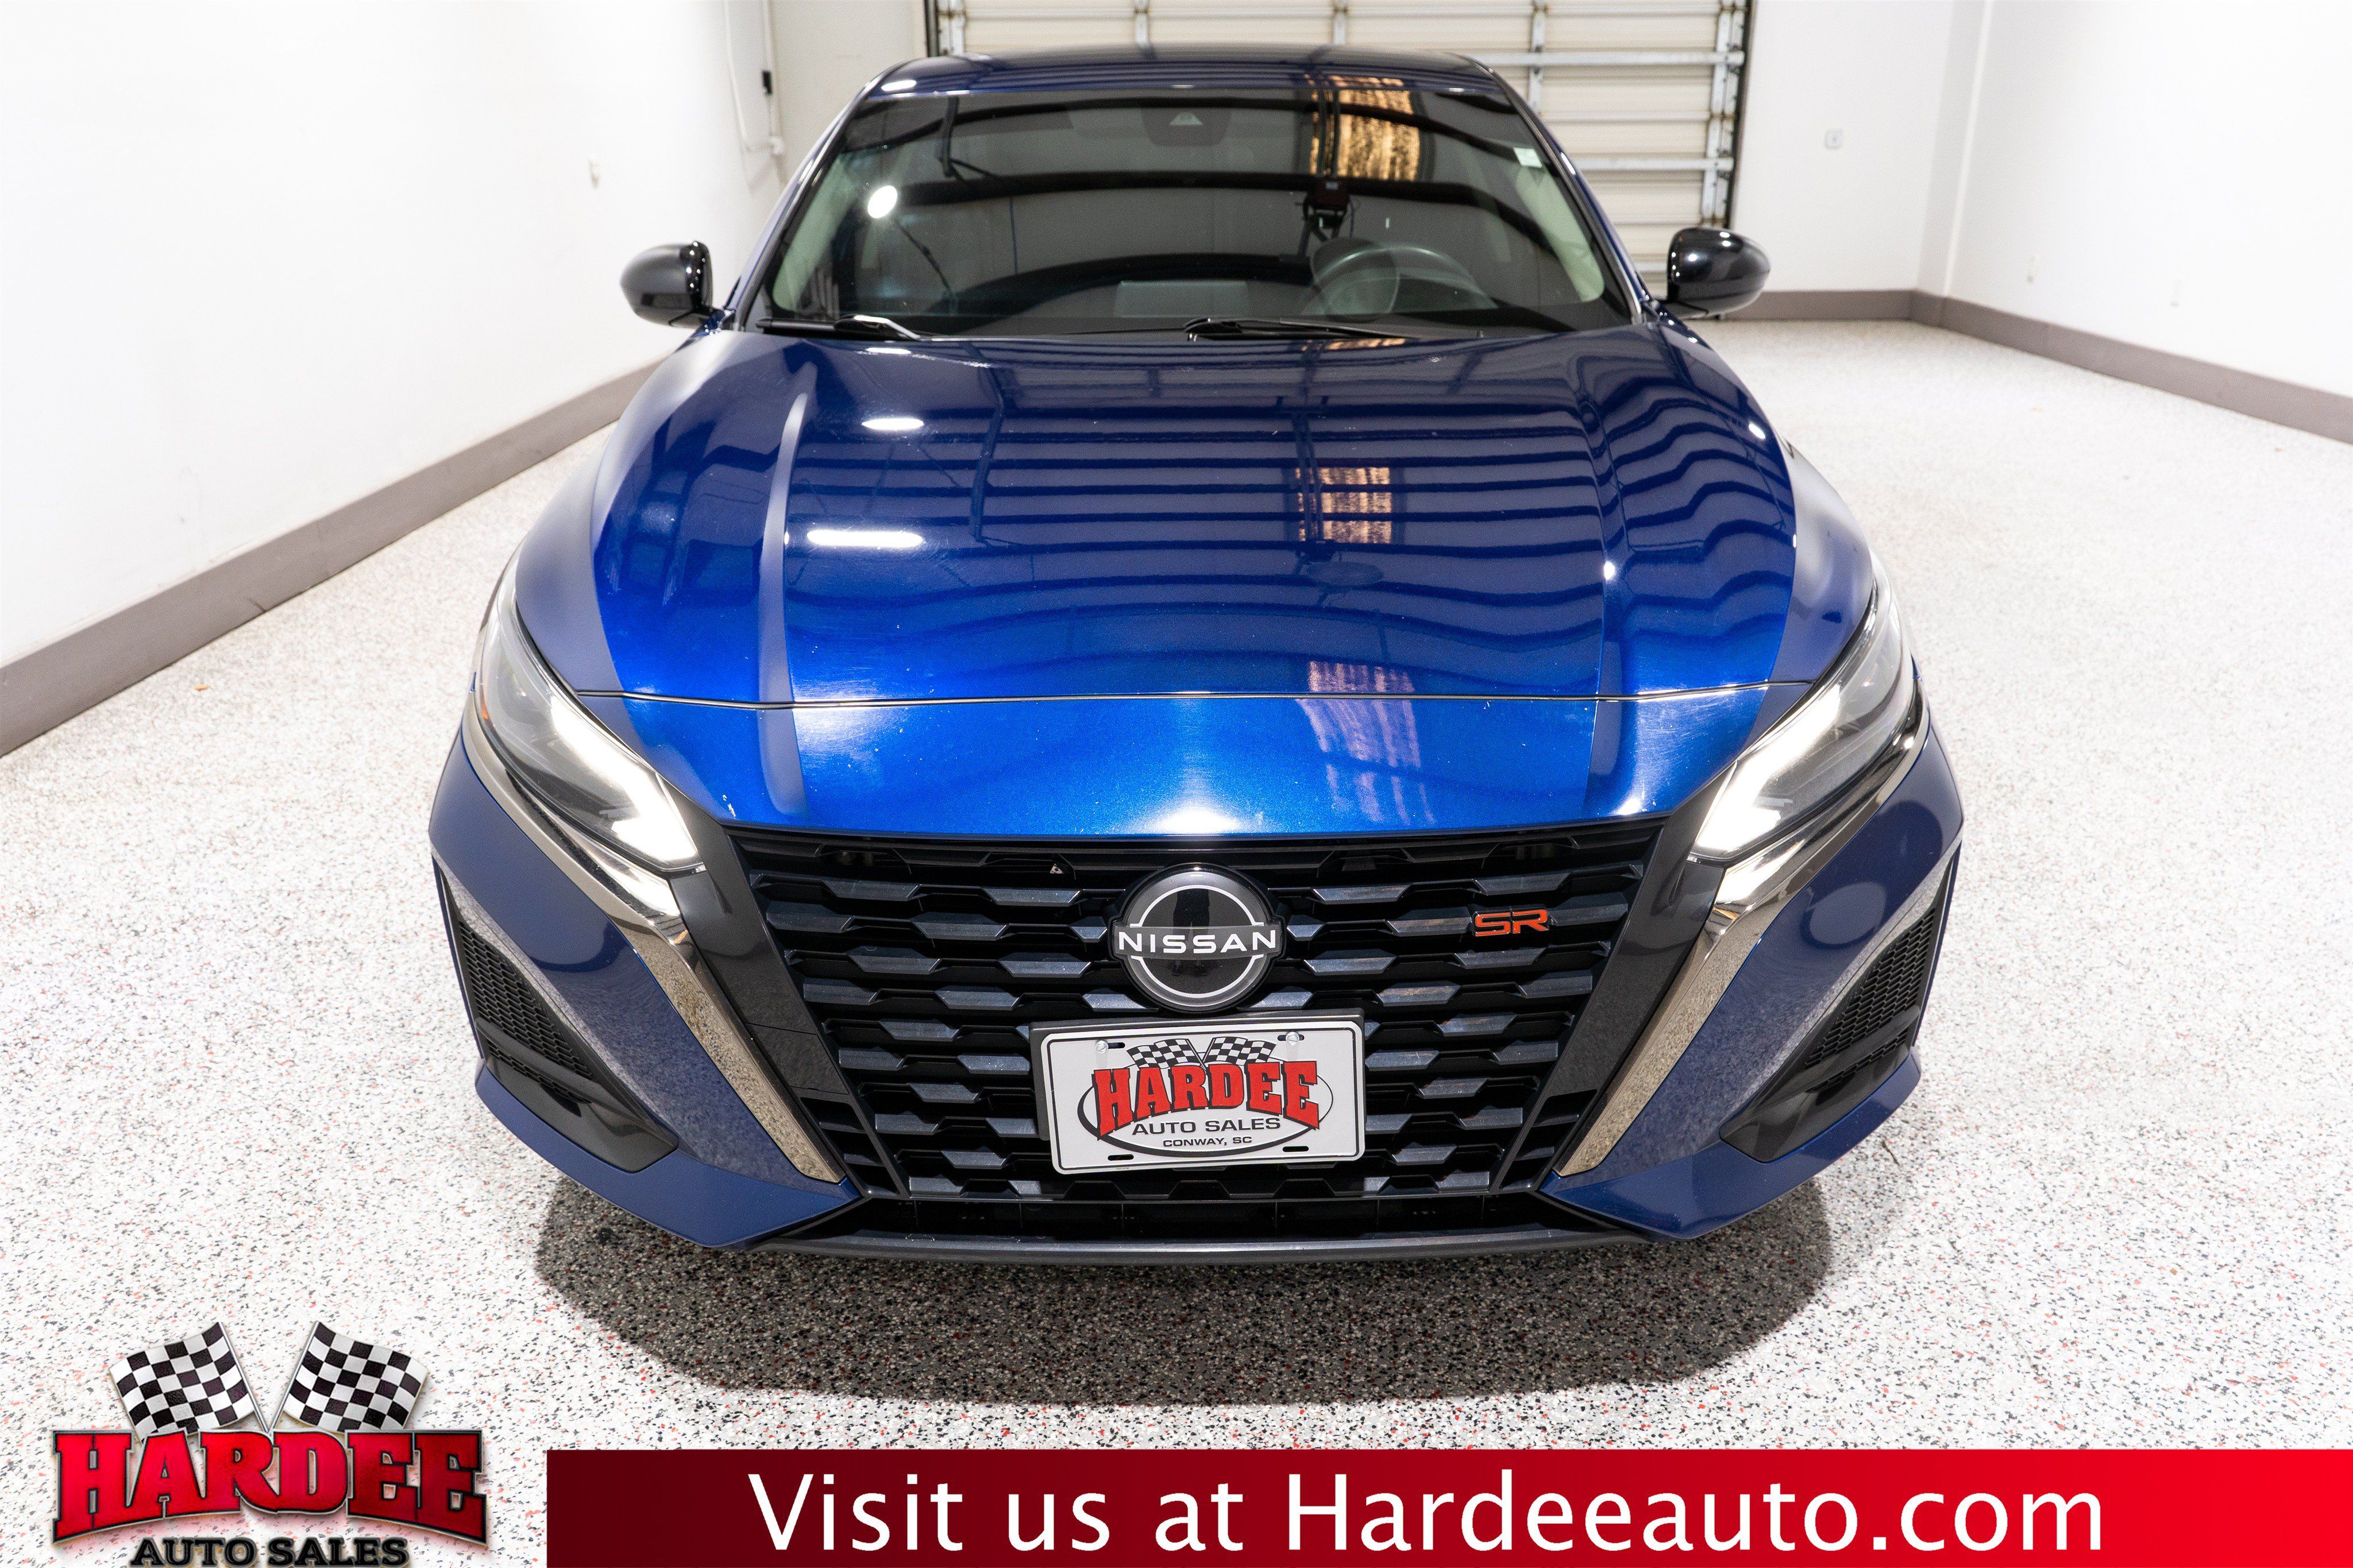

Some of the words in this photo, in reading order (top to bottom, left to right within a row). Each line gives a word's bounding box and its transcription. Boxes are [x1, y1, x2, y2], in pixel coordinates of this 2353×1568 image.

[1475, 909, 1549, 937] SR
[1118, 929, 1276, 954] NISSAN
[1093, 1060, 1320, 1141] HARDEE
[1132, 1120, 1197, 1136] AUTO
[1205, 1117, 1281, 1131] SALES
[1163, 1137, 1227, 1148] CONWAY,
[1232, 1136, 1252, 1144] SC
